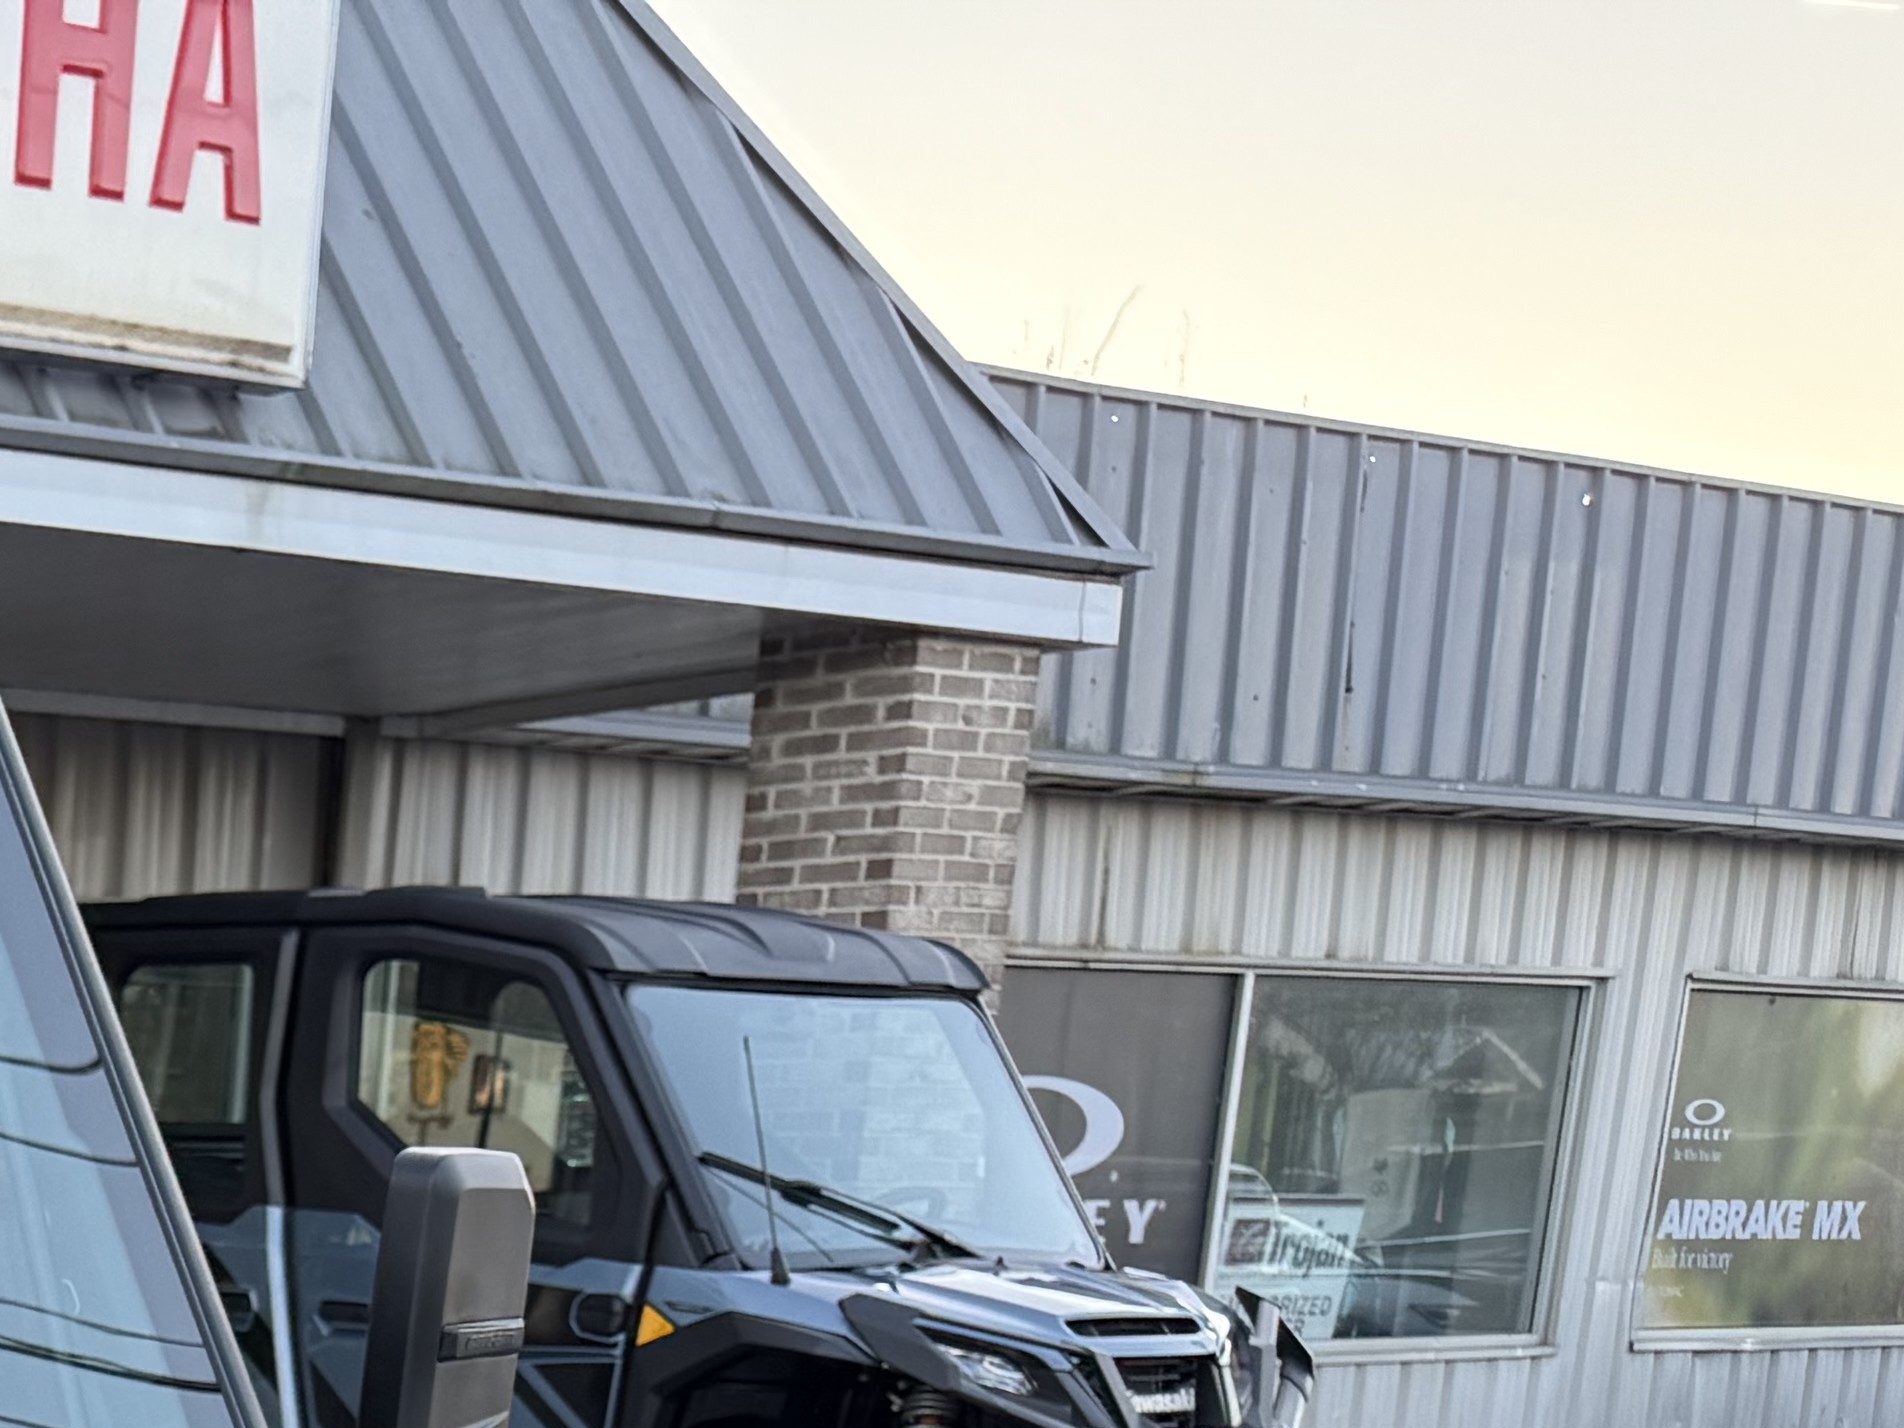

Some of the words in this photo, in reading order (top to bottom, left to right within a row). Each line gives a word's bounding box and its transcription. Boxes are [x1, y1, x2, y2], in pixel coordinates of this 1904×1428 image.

[1671, 1128, 1732, 1142] OAKLEY
[1656, 1199, 1808, 1241] AIRBRAKE
[1811, 1200, 1867, 1241] MX
